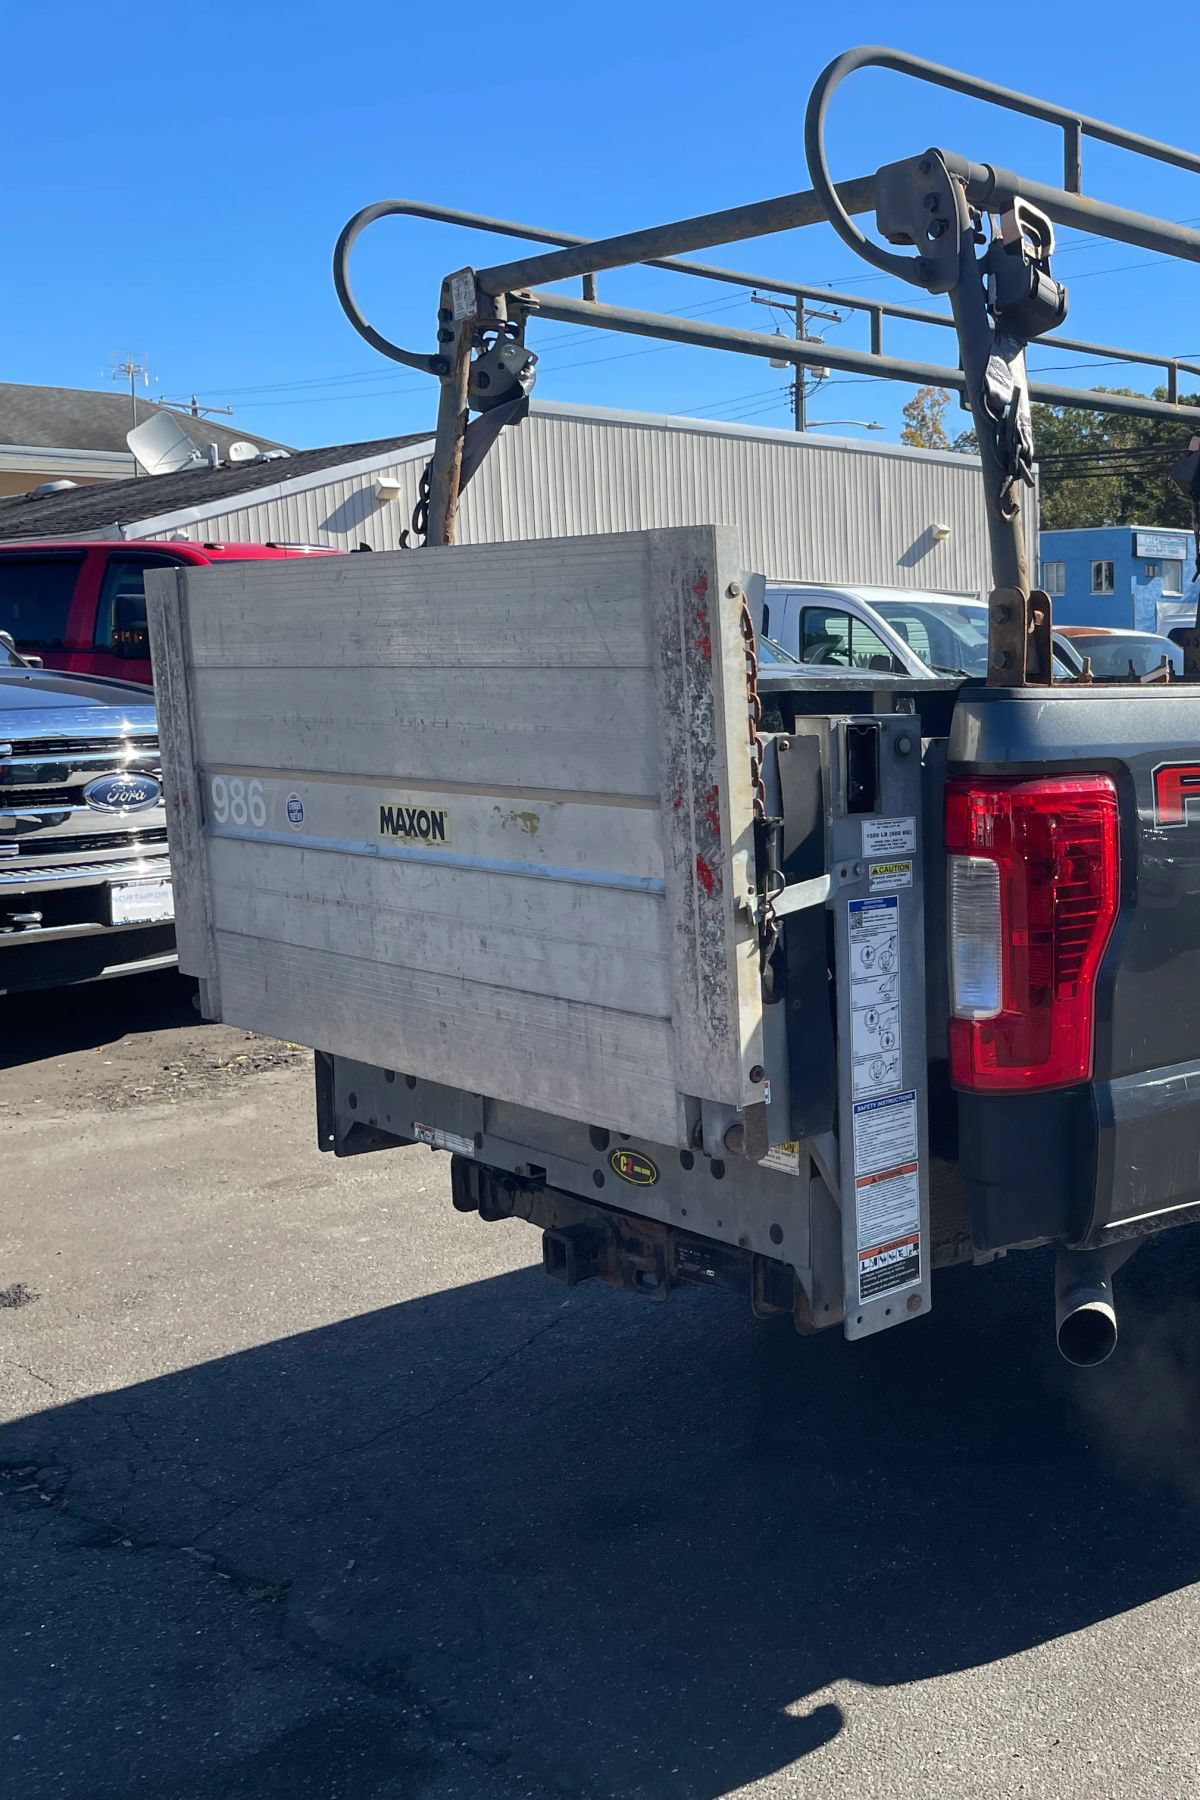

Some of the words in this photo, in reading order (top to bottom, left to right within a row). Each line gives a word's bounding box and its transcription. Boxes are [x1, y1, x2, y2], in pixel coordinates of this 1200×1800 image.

[107, 782, 147, 803] Ford
[211, 776, 266, 827] 986
[380, 806, 446, 840] MAXON
[878, 863, 910, 874] CAUTION
[857, 1102, 877, 1112] SAFETY
[877, 1093, 913, 1107] INSTRUCTIONS
